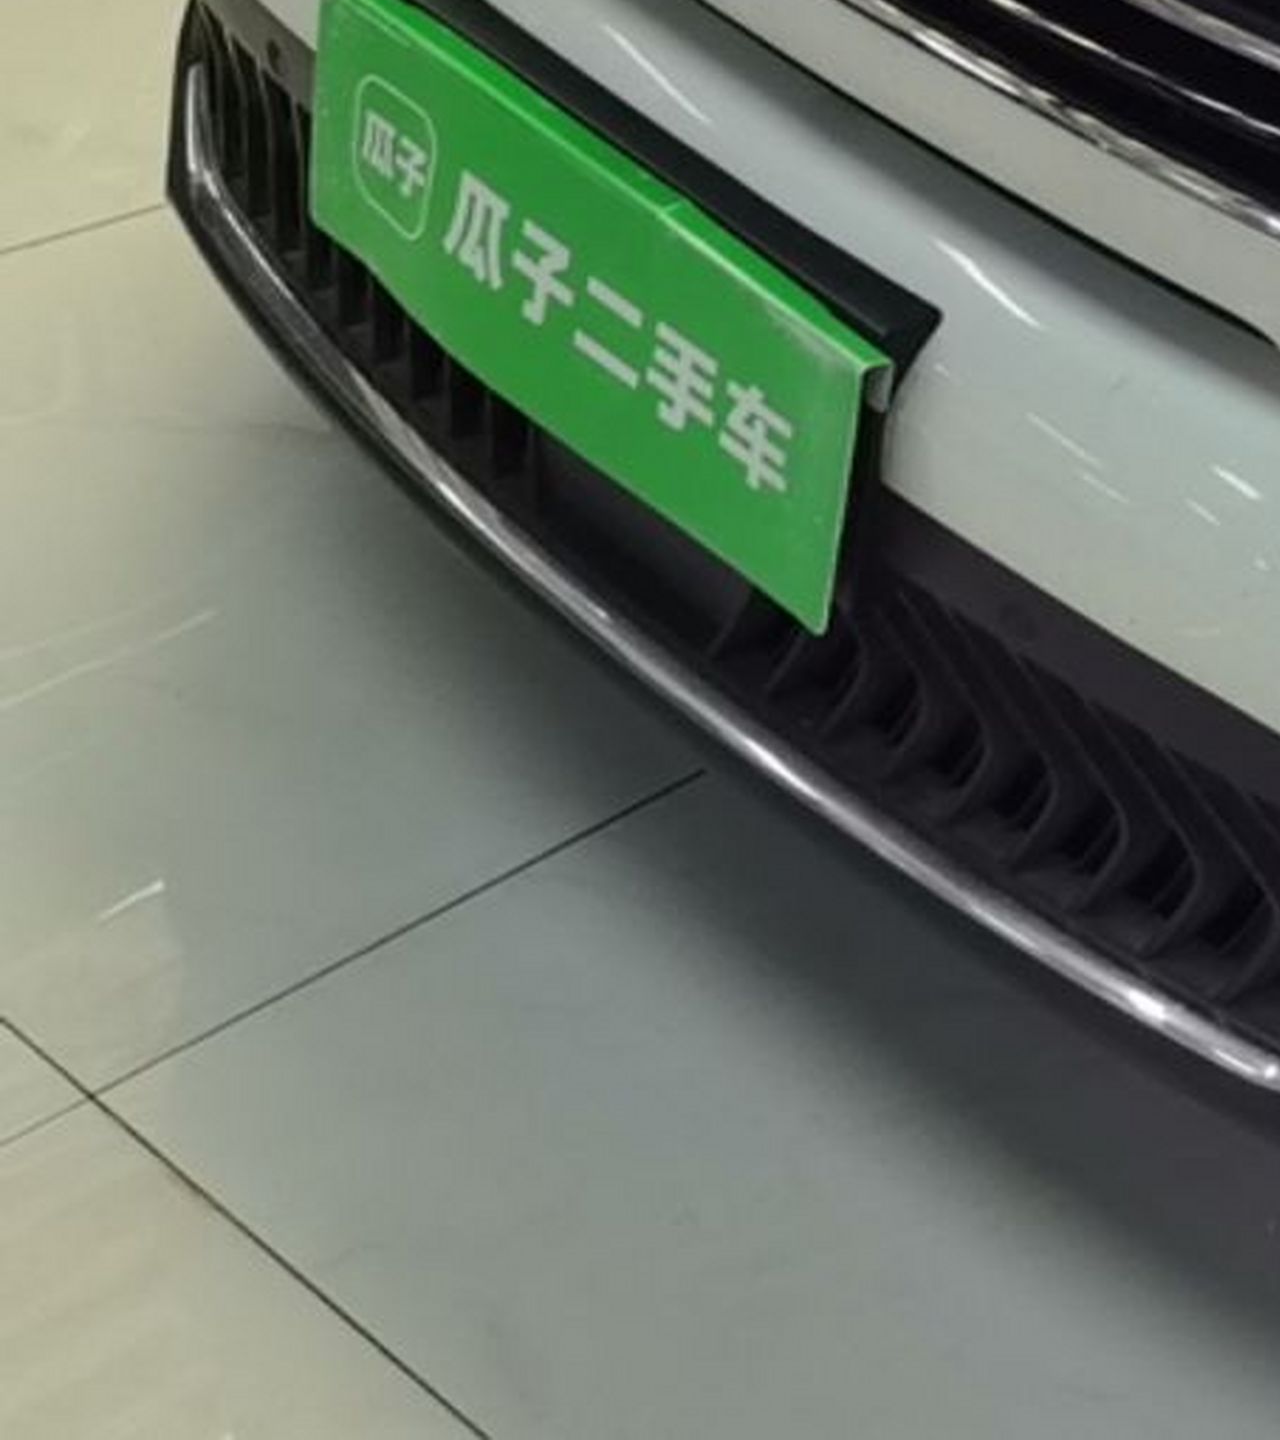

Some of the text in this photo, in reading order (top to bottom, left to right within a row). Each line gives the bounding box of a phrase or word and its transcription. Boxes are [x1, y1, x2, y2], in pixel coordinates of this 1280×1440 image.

[362, 109, 427, 197] 瓜子
[442, 171, 794, 492] 瓜子二手车
